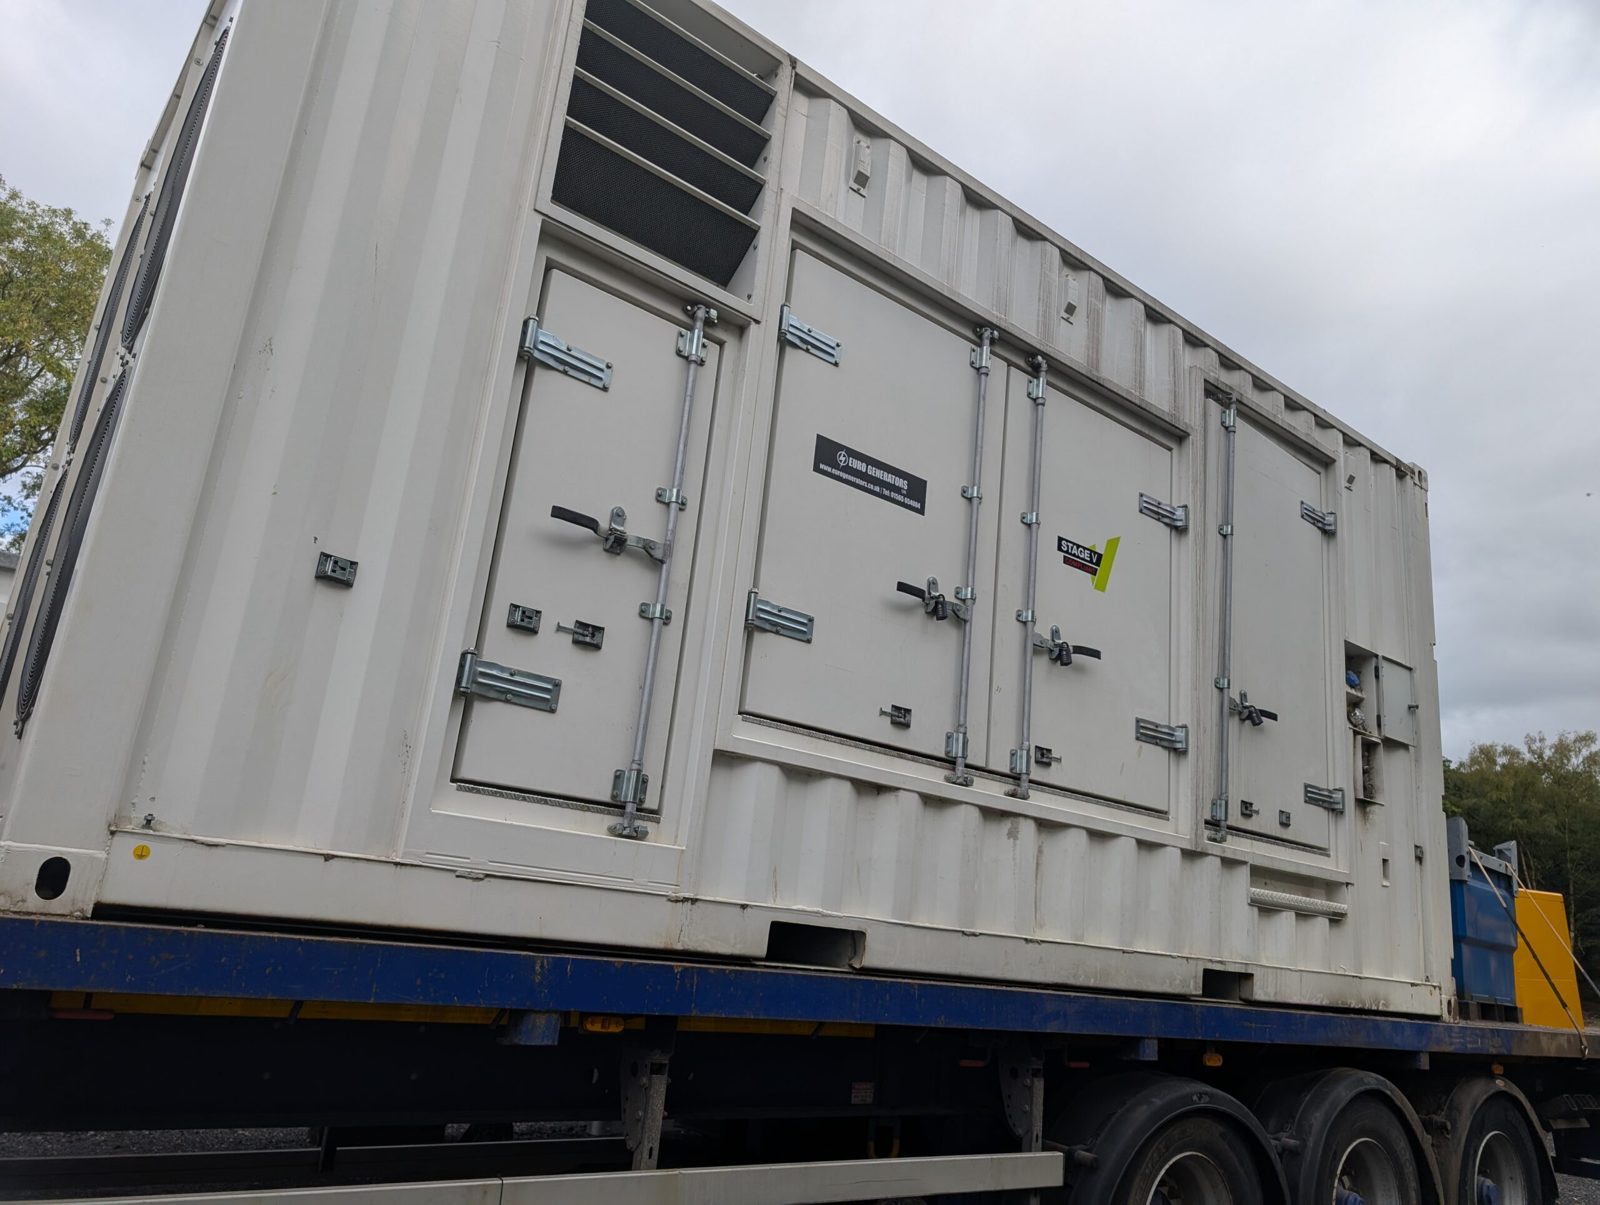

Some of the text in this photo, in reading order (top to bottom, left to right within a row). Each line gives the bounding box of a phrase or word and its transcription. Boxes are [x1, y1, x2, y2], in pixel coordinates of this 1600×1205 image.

[819, 463, 880, 493] www.eurogenerators.co.uk
[849, 457, 908, 490] EURO GENERATORS
[1061, 540, 1098, 563] STAGE V
